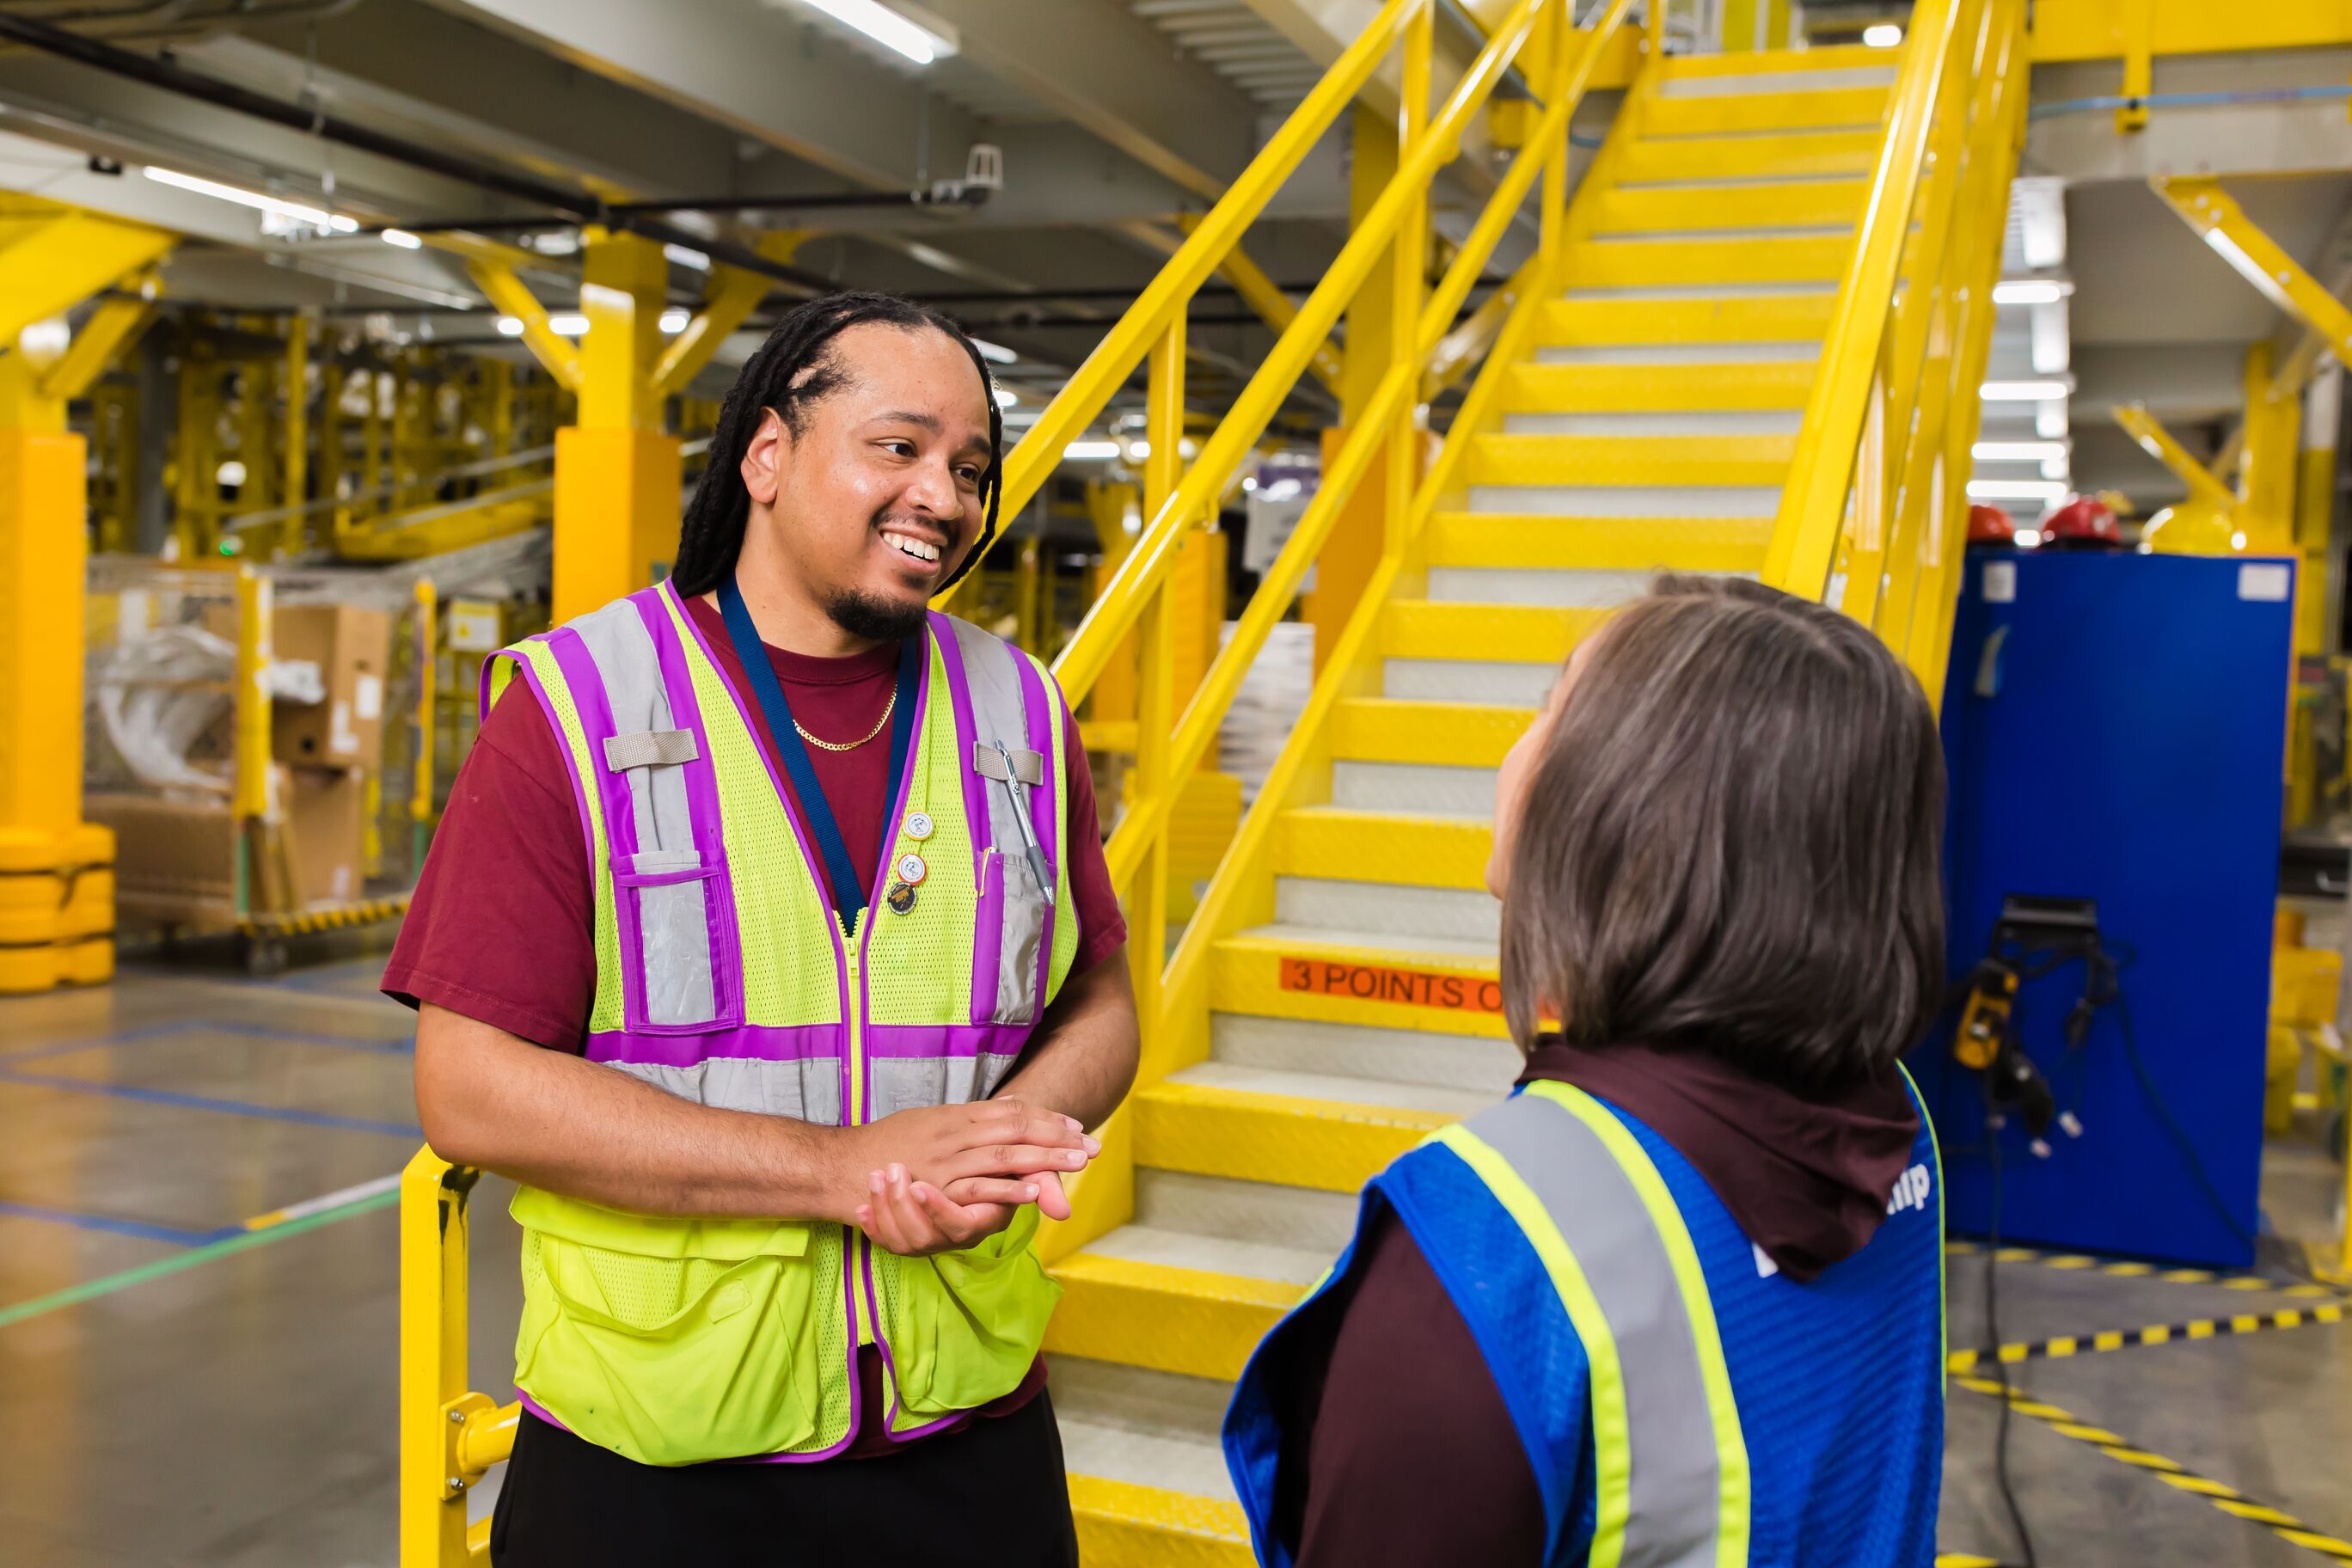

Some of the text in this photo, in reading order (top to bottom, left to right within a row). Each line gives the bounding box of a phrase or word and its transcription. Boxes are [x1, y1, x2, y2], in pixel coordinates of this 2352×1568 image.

[1293, 960, 1504, 1013] 3 POINTS O
